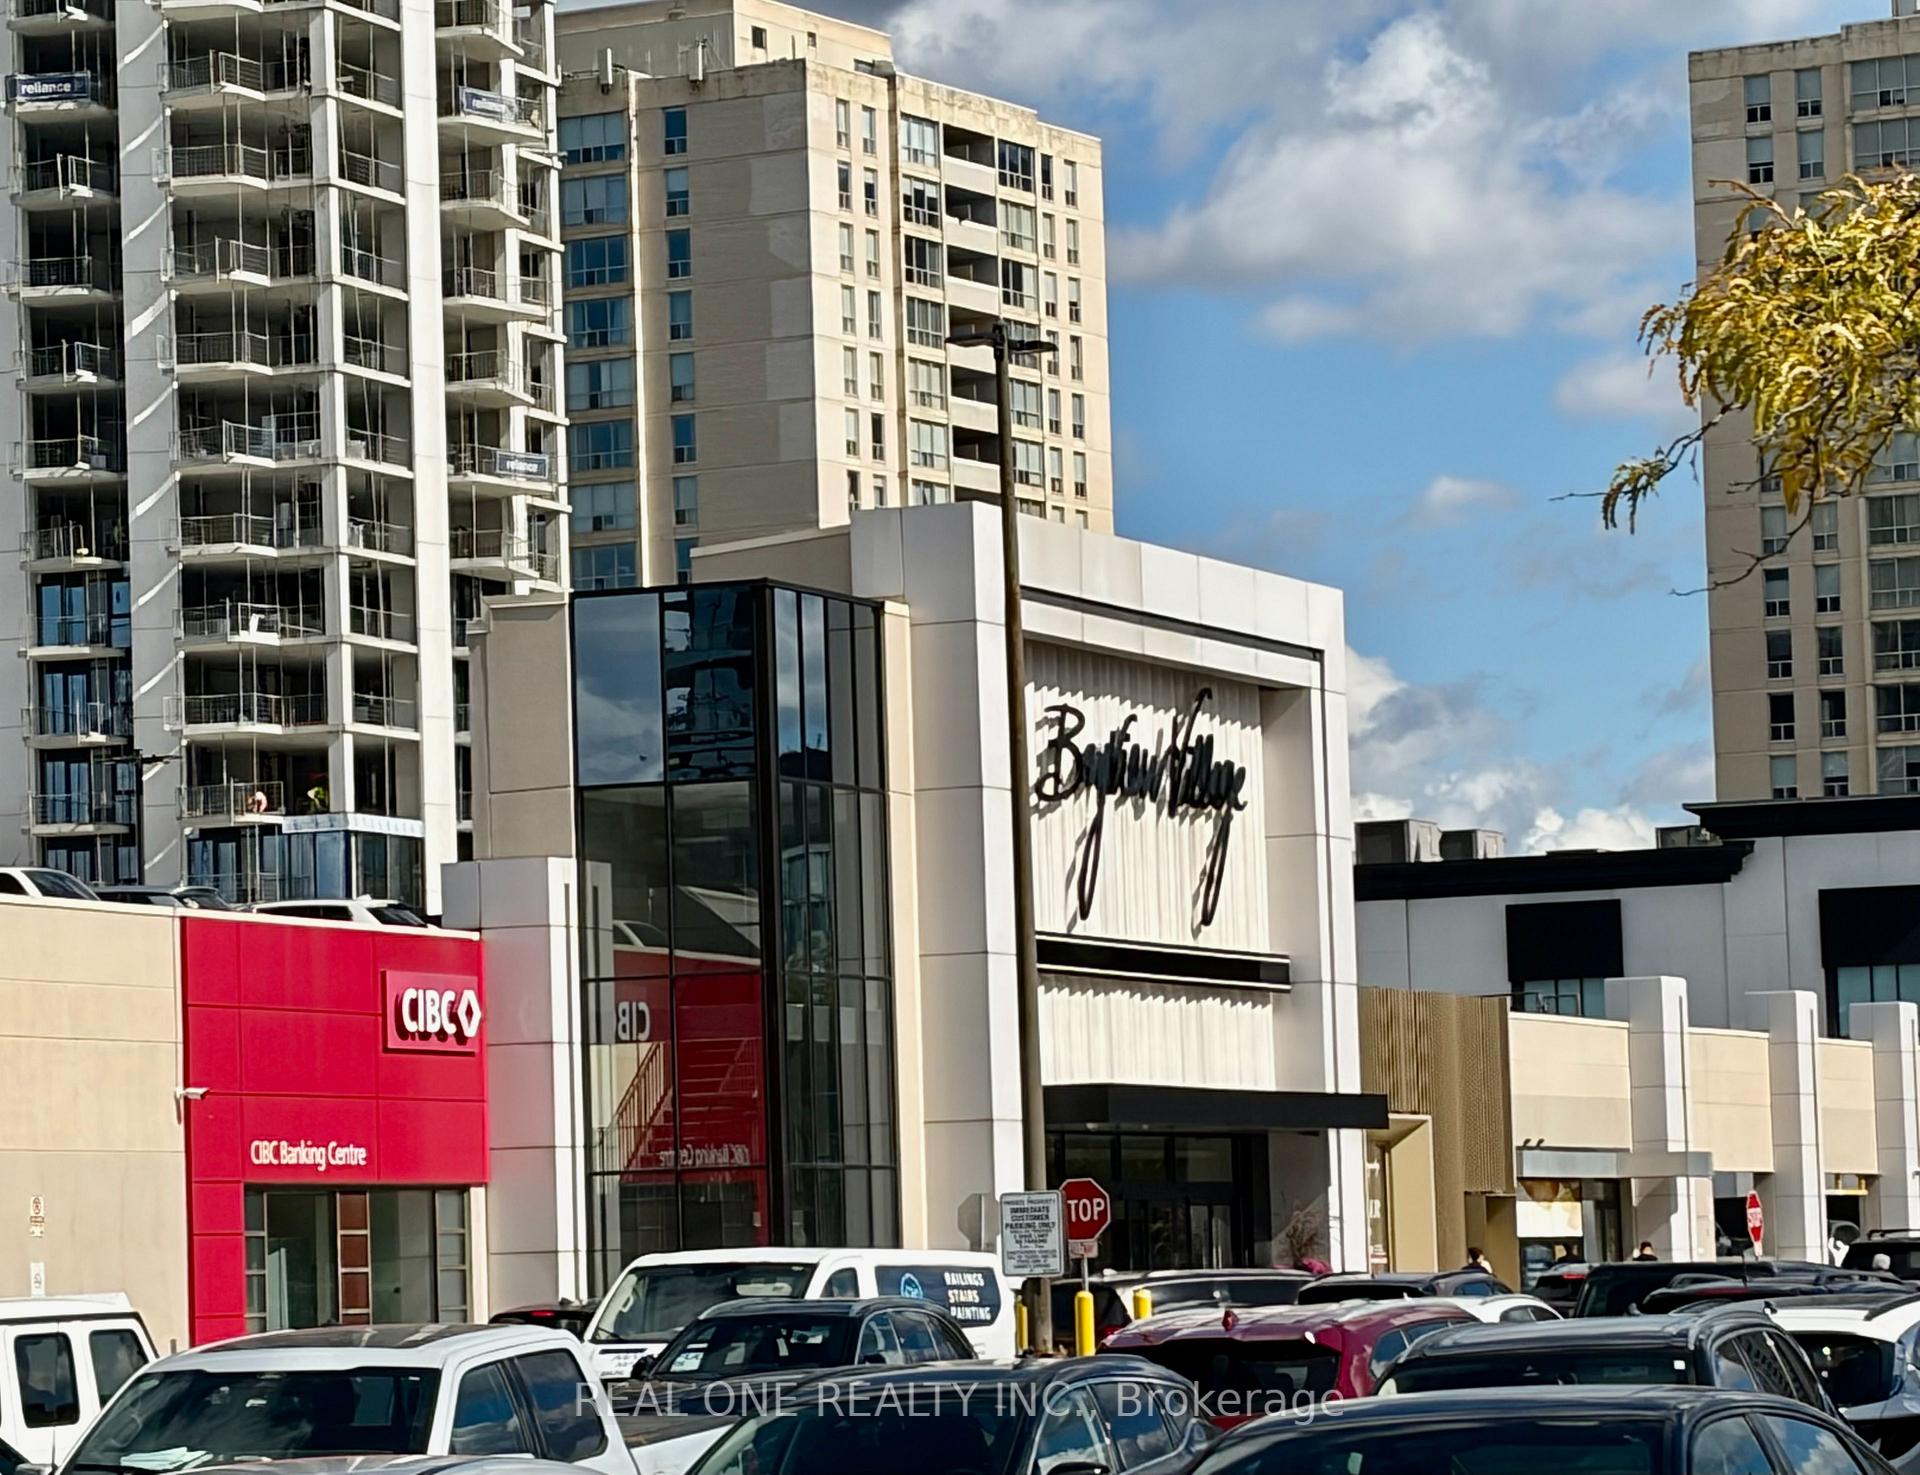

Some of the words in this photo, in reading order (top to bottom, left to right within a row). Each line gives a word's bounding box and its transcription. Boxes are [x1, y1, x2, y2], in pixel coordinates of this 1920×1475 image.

[21, 81, 72, 95] reliance
[402, 988, 457, 1035] CIBC
[250, 1140, 279, 1165] CIBC
[280, 1139, 326, 1171] Banking
[327, 1141, 367, 1166] Centre
[1067, 1198, 1105, 1222] TOP
[1004, 1222, 1037, 1230] PARKING
[944, 1271, 985, 1287] RAILINGS
[948, 1289, 980, 1304] STAIRS
[950, 1306, 992, 1321] PAINTING
